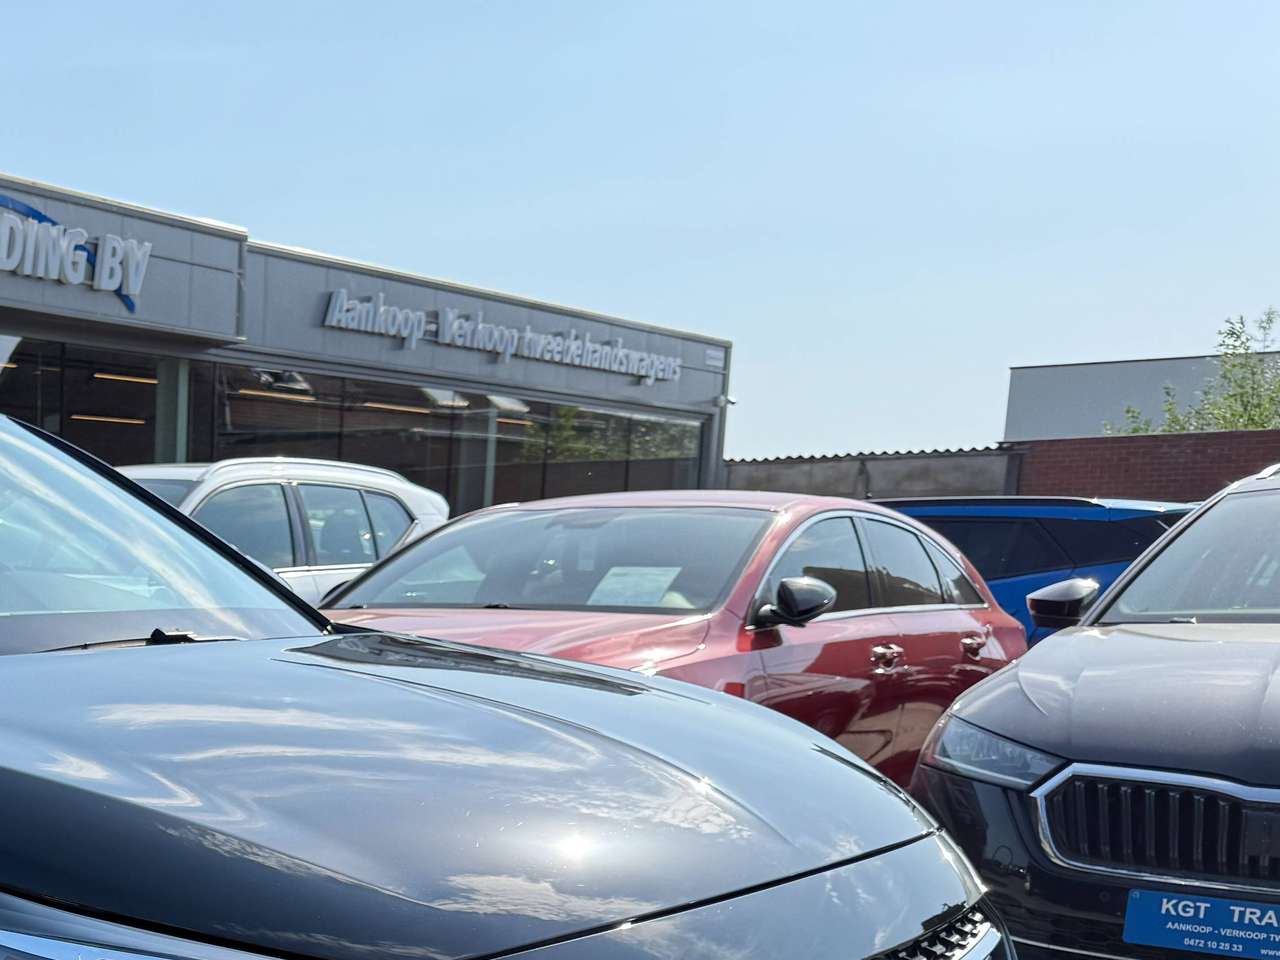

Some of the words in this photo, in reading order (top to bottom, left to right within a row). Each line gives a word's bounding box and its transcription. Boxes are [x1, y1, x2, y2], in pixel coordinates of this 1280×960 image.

[92, 233, 152, 295] BV
[521, 324, 682, 386] tweedehandswagens
[1160, 898, 1210, 919] KGT
[1166, 921, 1213, 934] AANKOOP
[1220, 928, 1267, 941] VERKOOP
[1183, 937, 1205, 947] 0472
[1207, 940, 1217, 949] 10
[1231, 943, 1243, 952] 33
